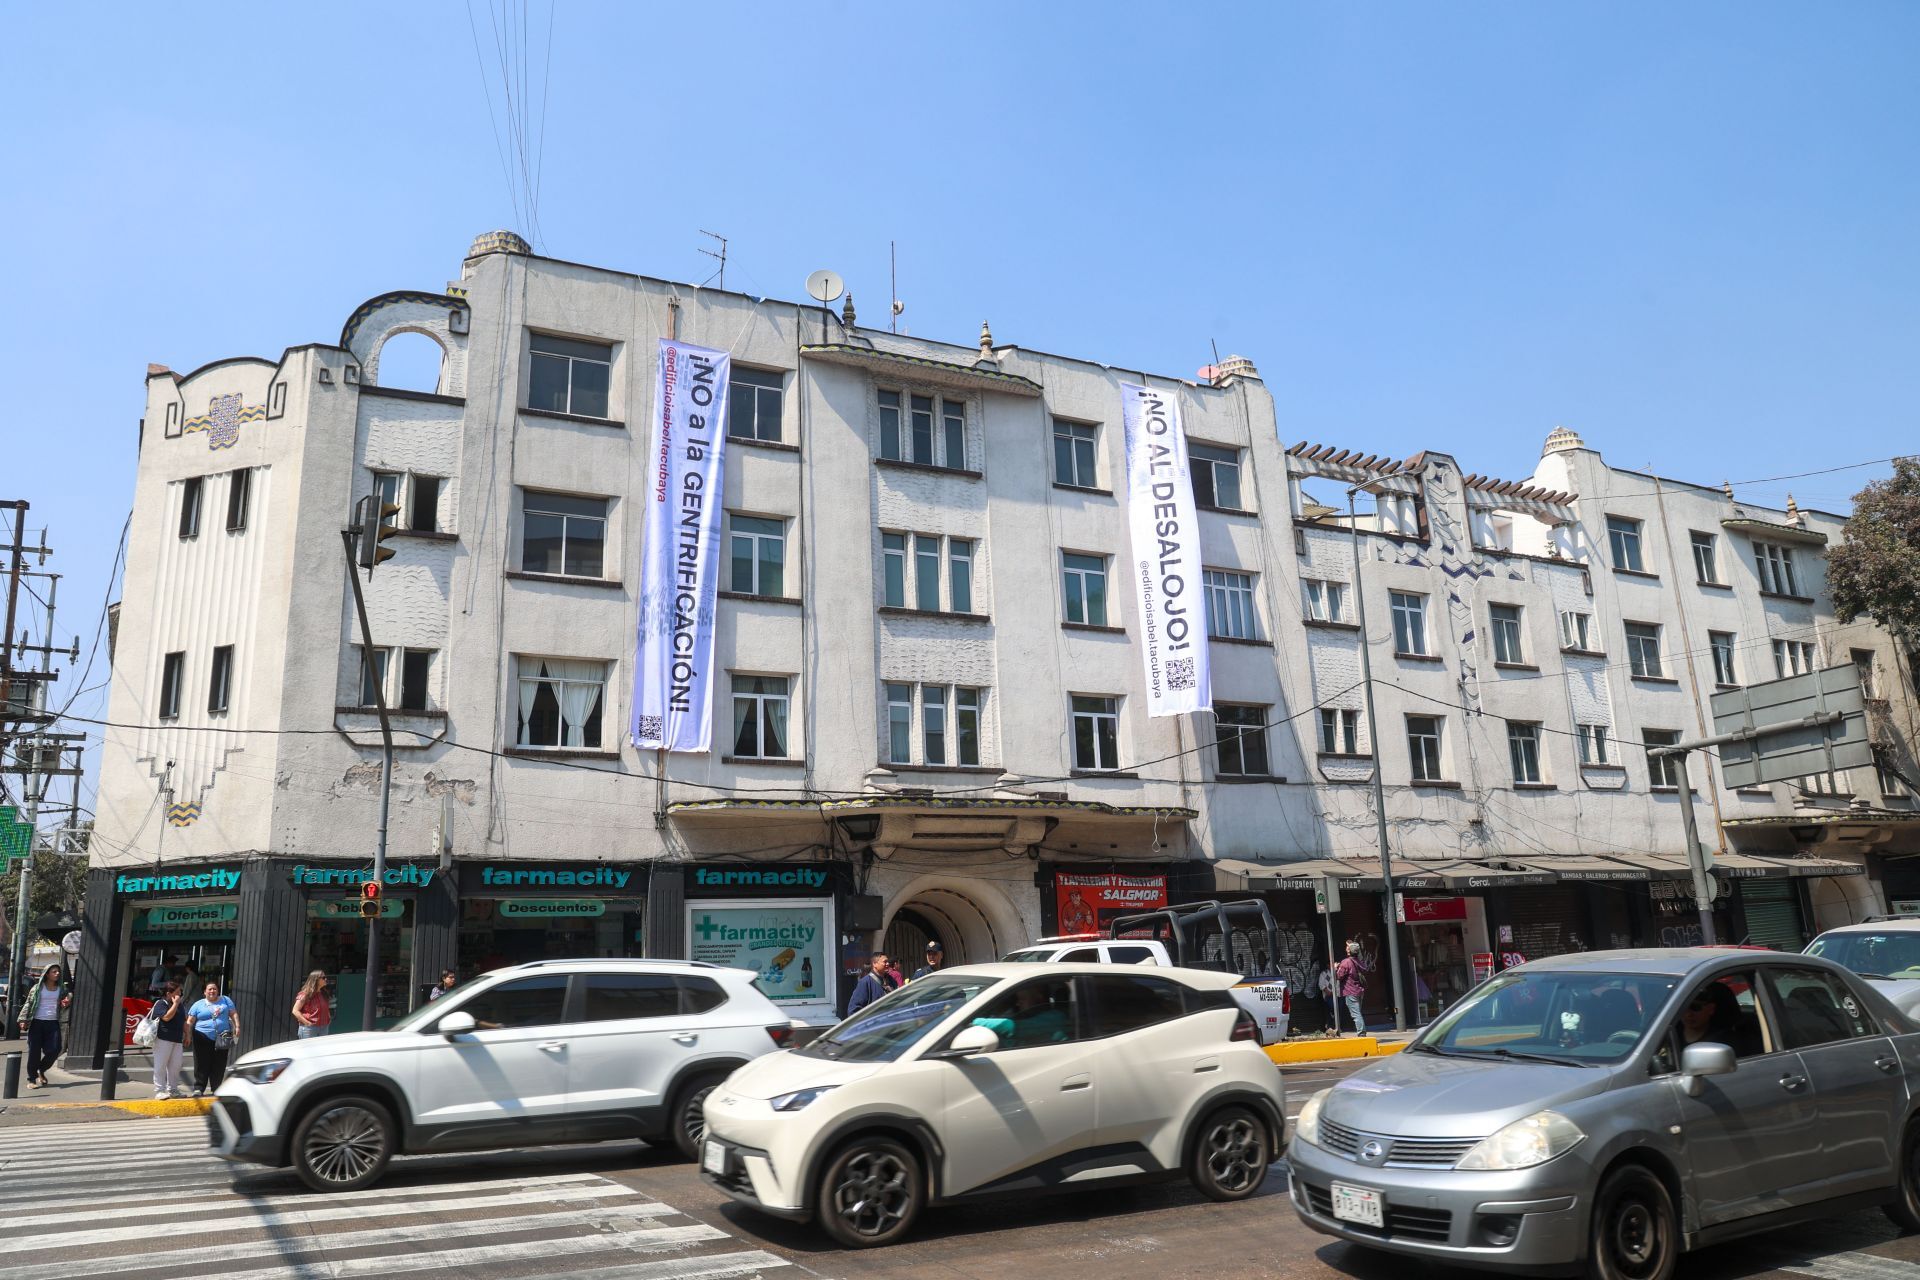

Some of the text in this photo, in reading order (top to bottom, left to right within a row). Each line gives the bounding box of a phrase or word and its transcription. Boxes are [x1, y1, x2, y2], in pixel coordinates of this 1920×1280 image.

[657, 346, 677, 503] @edificioisabel.tacubaya
[1138, 391, 1190, 652] ¡NO AL DESALOJO!
[669, 353, 713, 714] ¡NO a la GENTRIFICACIÓN!
[1139, 560, 1162, 699] @edificioisabel.tacubaya
[117, 868, 242, 893] farmacity
[482, 867, 631, 888] farmacity
[696, 868, 828, 888] farmacity
[1103, 889, 1159, 901] SALGMOR
[508, 903, 598, 914] Descuentos
[720, 923, 816, 942] farmacity
